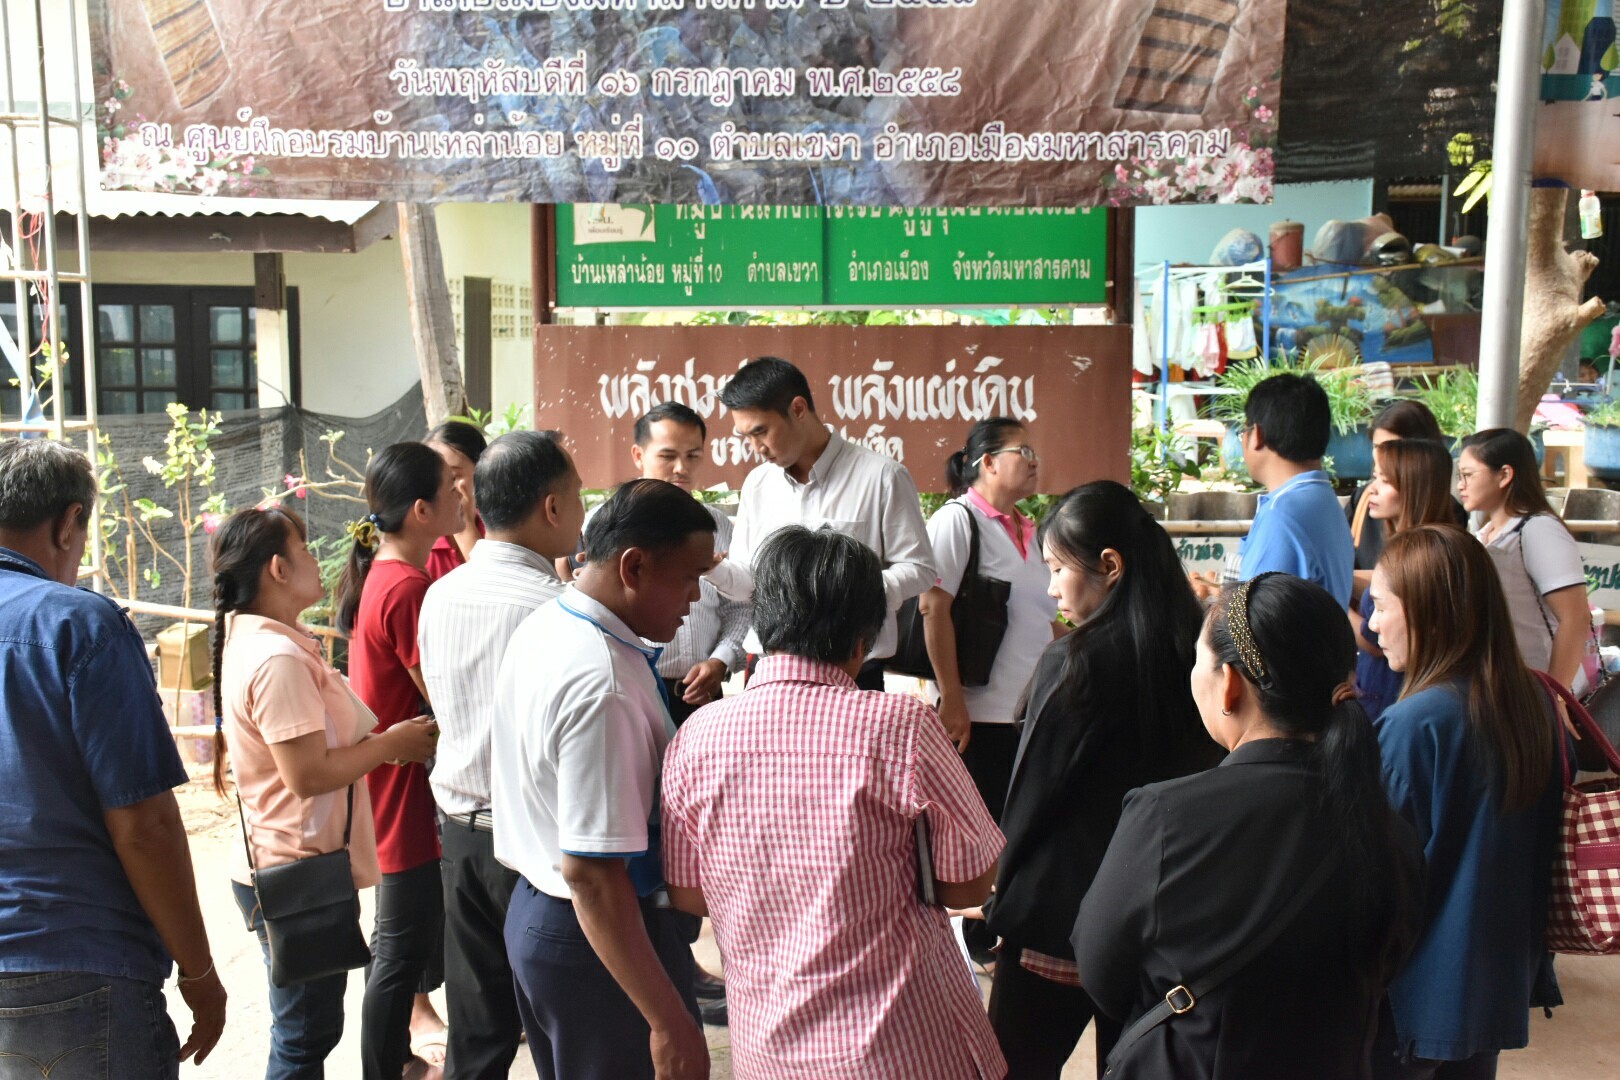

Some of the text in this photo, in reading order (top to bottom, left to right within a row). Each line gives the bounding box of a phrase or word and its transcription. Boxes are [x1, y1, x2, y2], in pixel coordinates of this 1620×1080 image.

[391, 52, 962, 106] วันพฤหัสบดีที่ ๑๖ กรกฎาคม พ.ศ.๒๕๕๘
[141, 122, 172, 150] ณ
[574, 113, 643, 171] หมู่ที่
[655, 137, 699, 160] ๑๐
[873, 121, 1231, 161] อำเภอเมืองมหาสารคาม
[571, 247, 1091, 296] บ้านเหล่าน้อย หมู่ที่ 10 ตำบลเขวา อำเภอเมือง จังหวัดมหาสารคาม
[828, 356, 1038, 423] พลังแผ่นดิน
